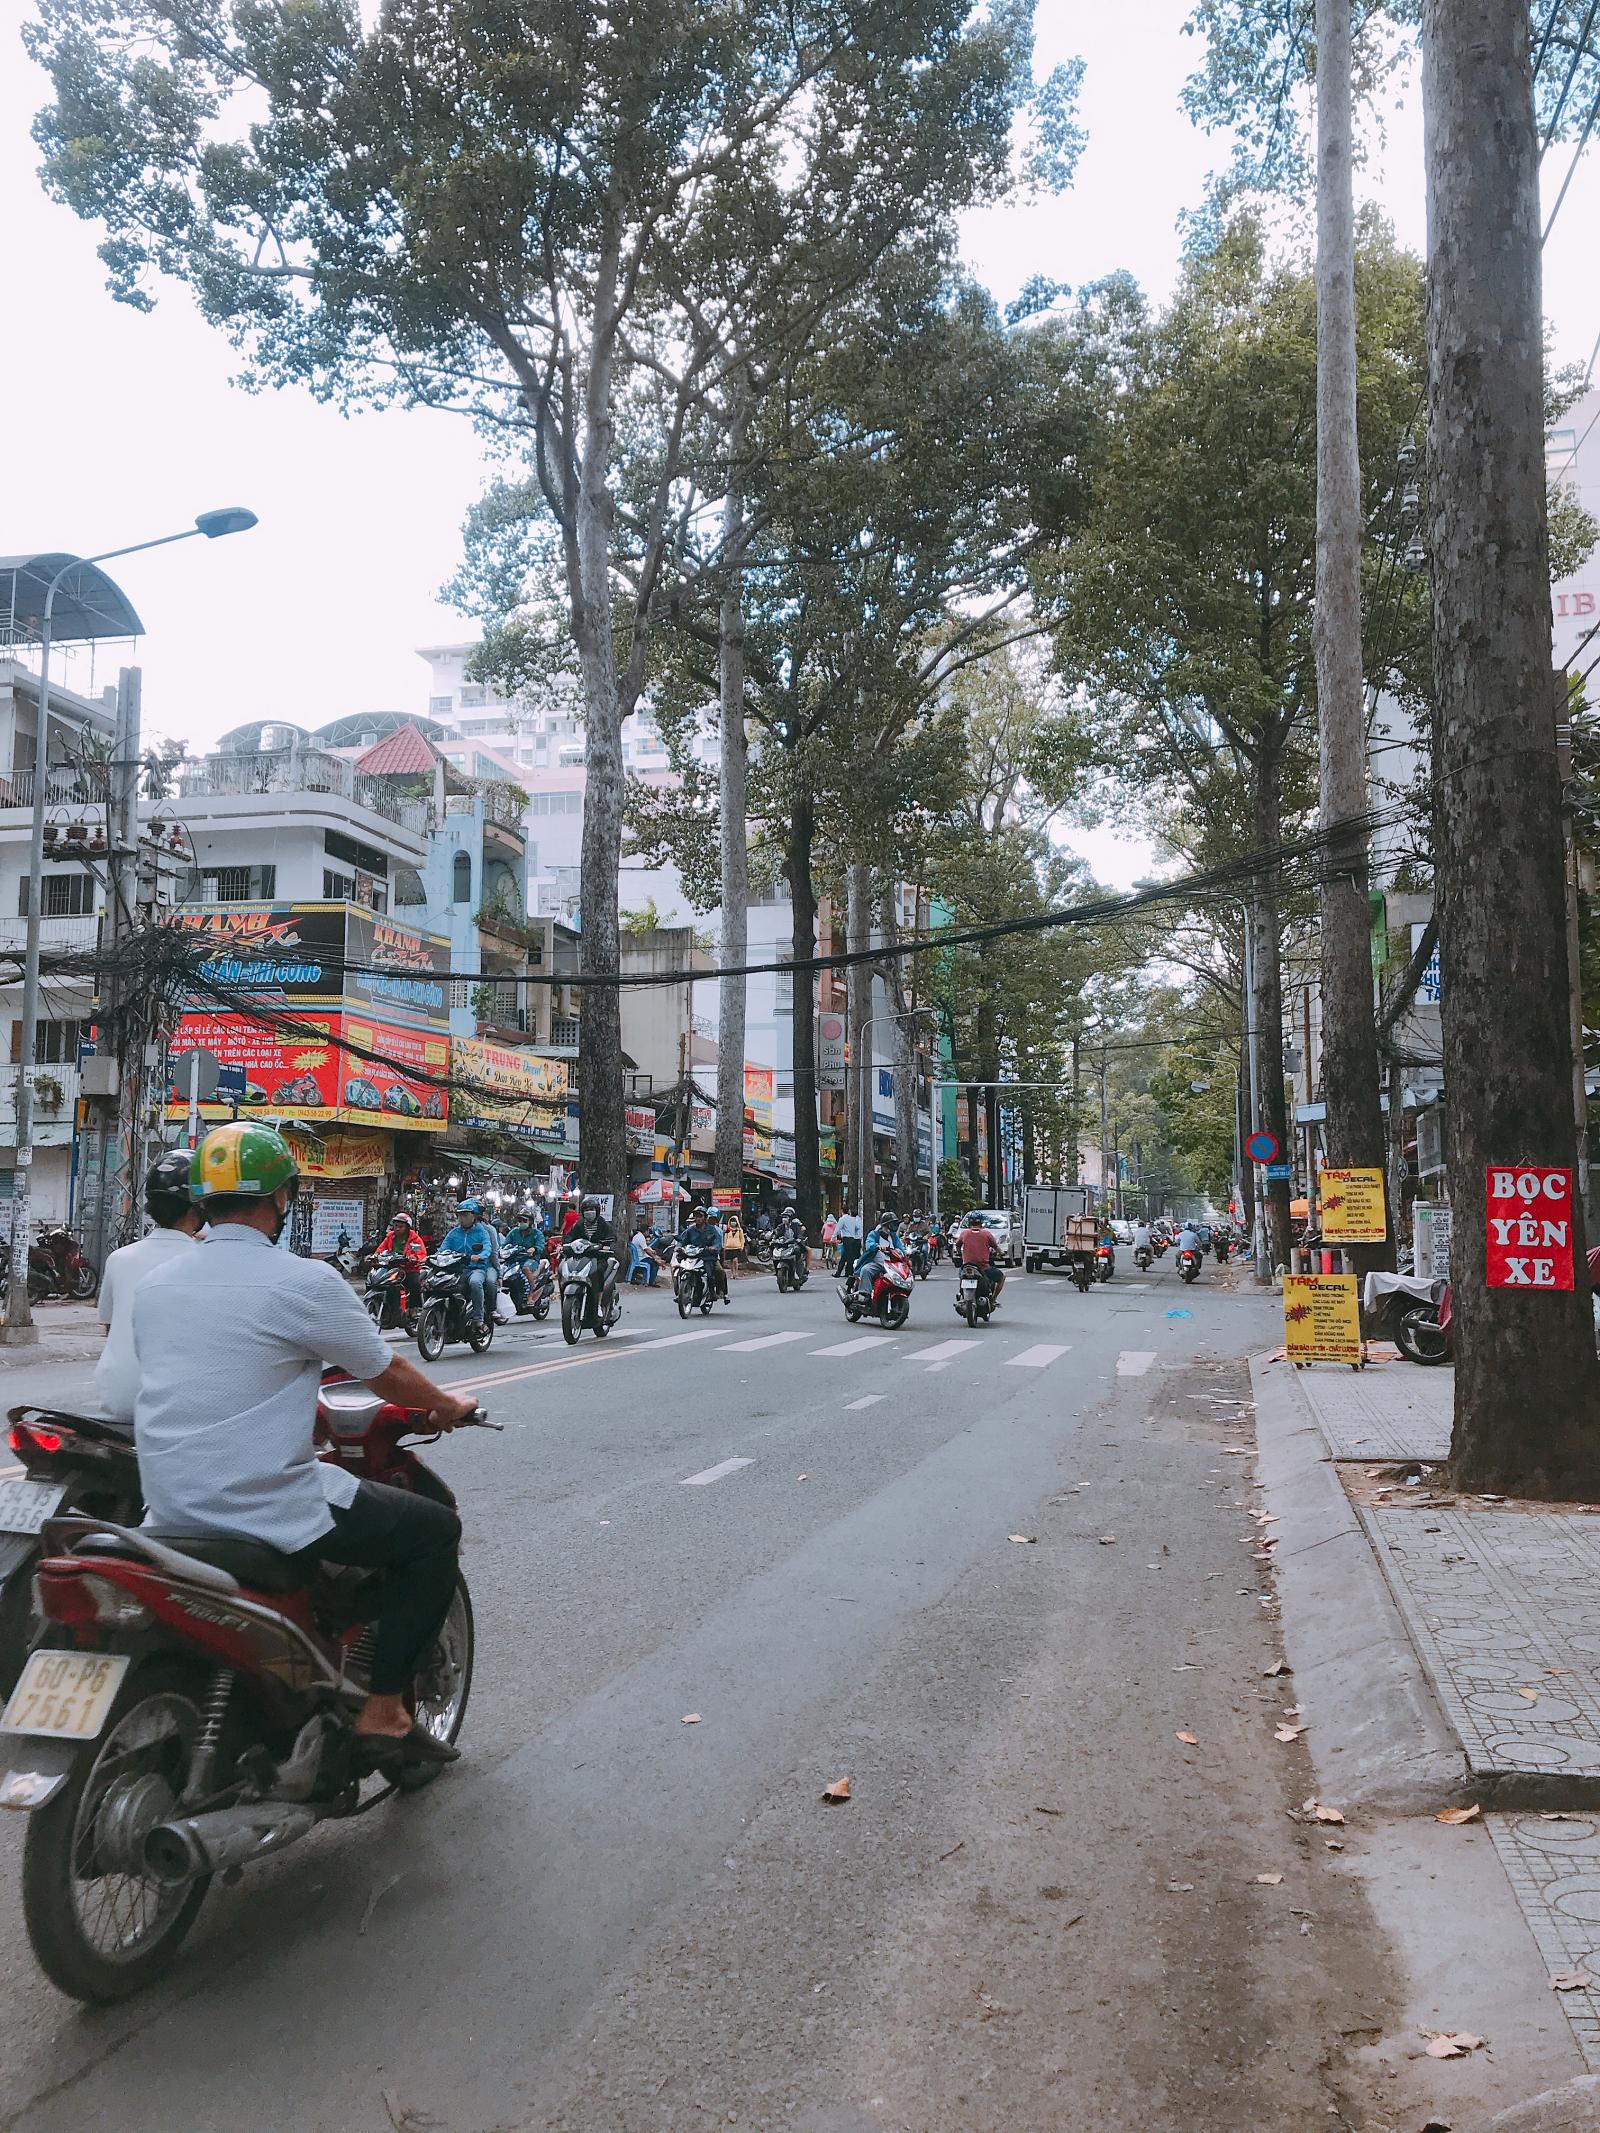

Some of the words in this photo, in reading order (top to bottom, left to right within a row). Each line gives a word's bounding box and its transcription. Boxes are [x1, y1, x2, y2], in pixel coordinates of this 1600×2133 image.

[202, 905, 226, 913] Design
[228, 904, 273, 913] Professional
[198, 1037, 206, 1046] XE
[208, 1035, 222, 1046] MÁY
[224, 1048, 241, 1058] TRÊN
[242, 1048, 256, 1057] CÁC
[257, 1048, 272, 1059] LOẠI
[273, 1049, 282, 1057] XE
[484, 1048, 521, 1070] TRUNG
[260, 1060, 273, 1069] CAO
[1492, 1172, 1566, 1205] BỌC
[1491, 1211, 1568, 1248] YÊN
[1504, 1257, 1556, 1285] XE
